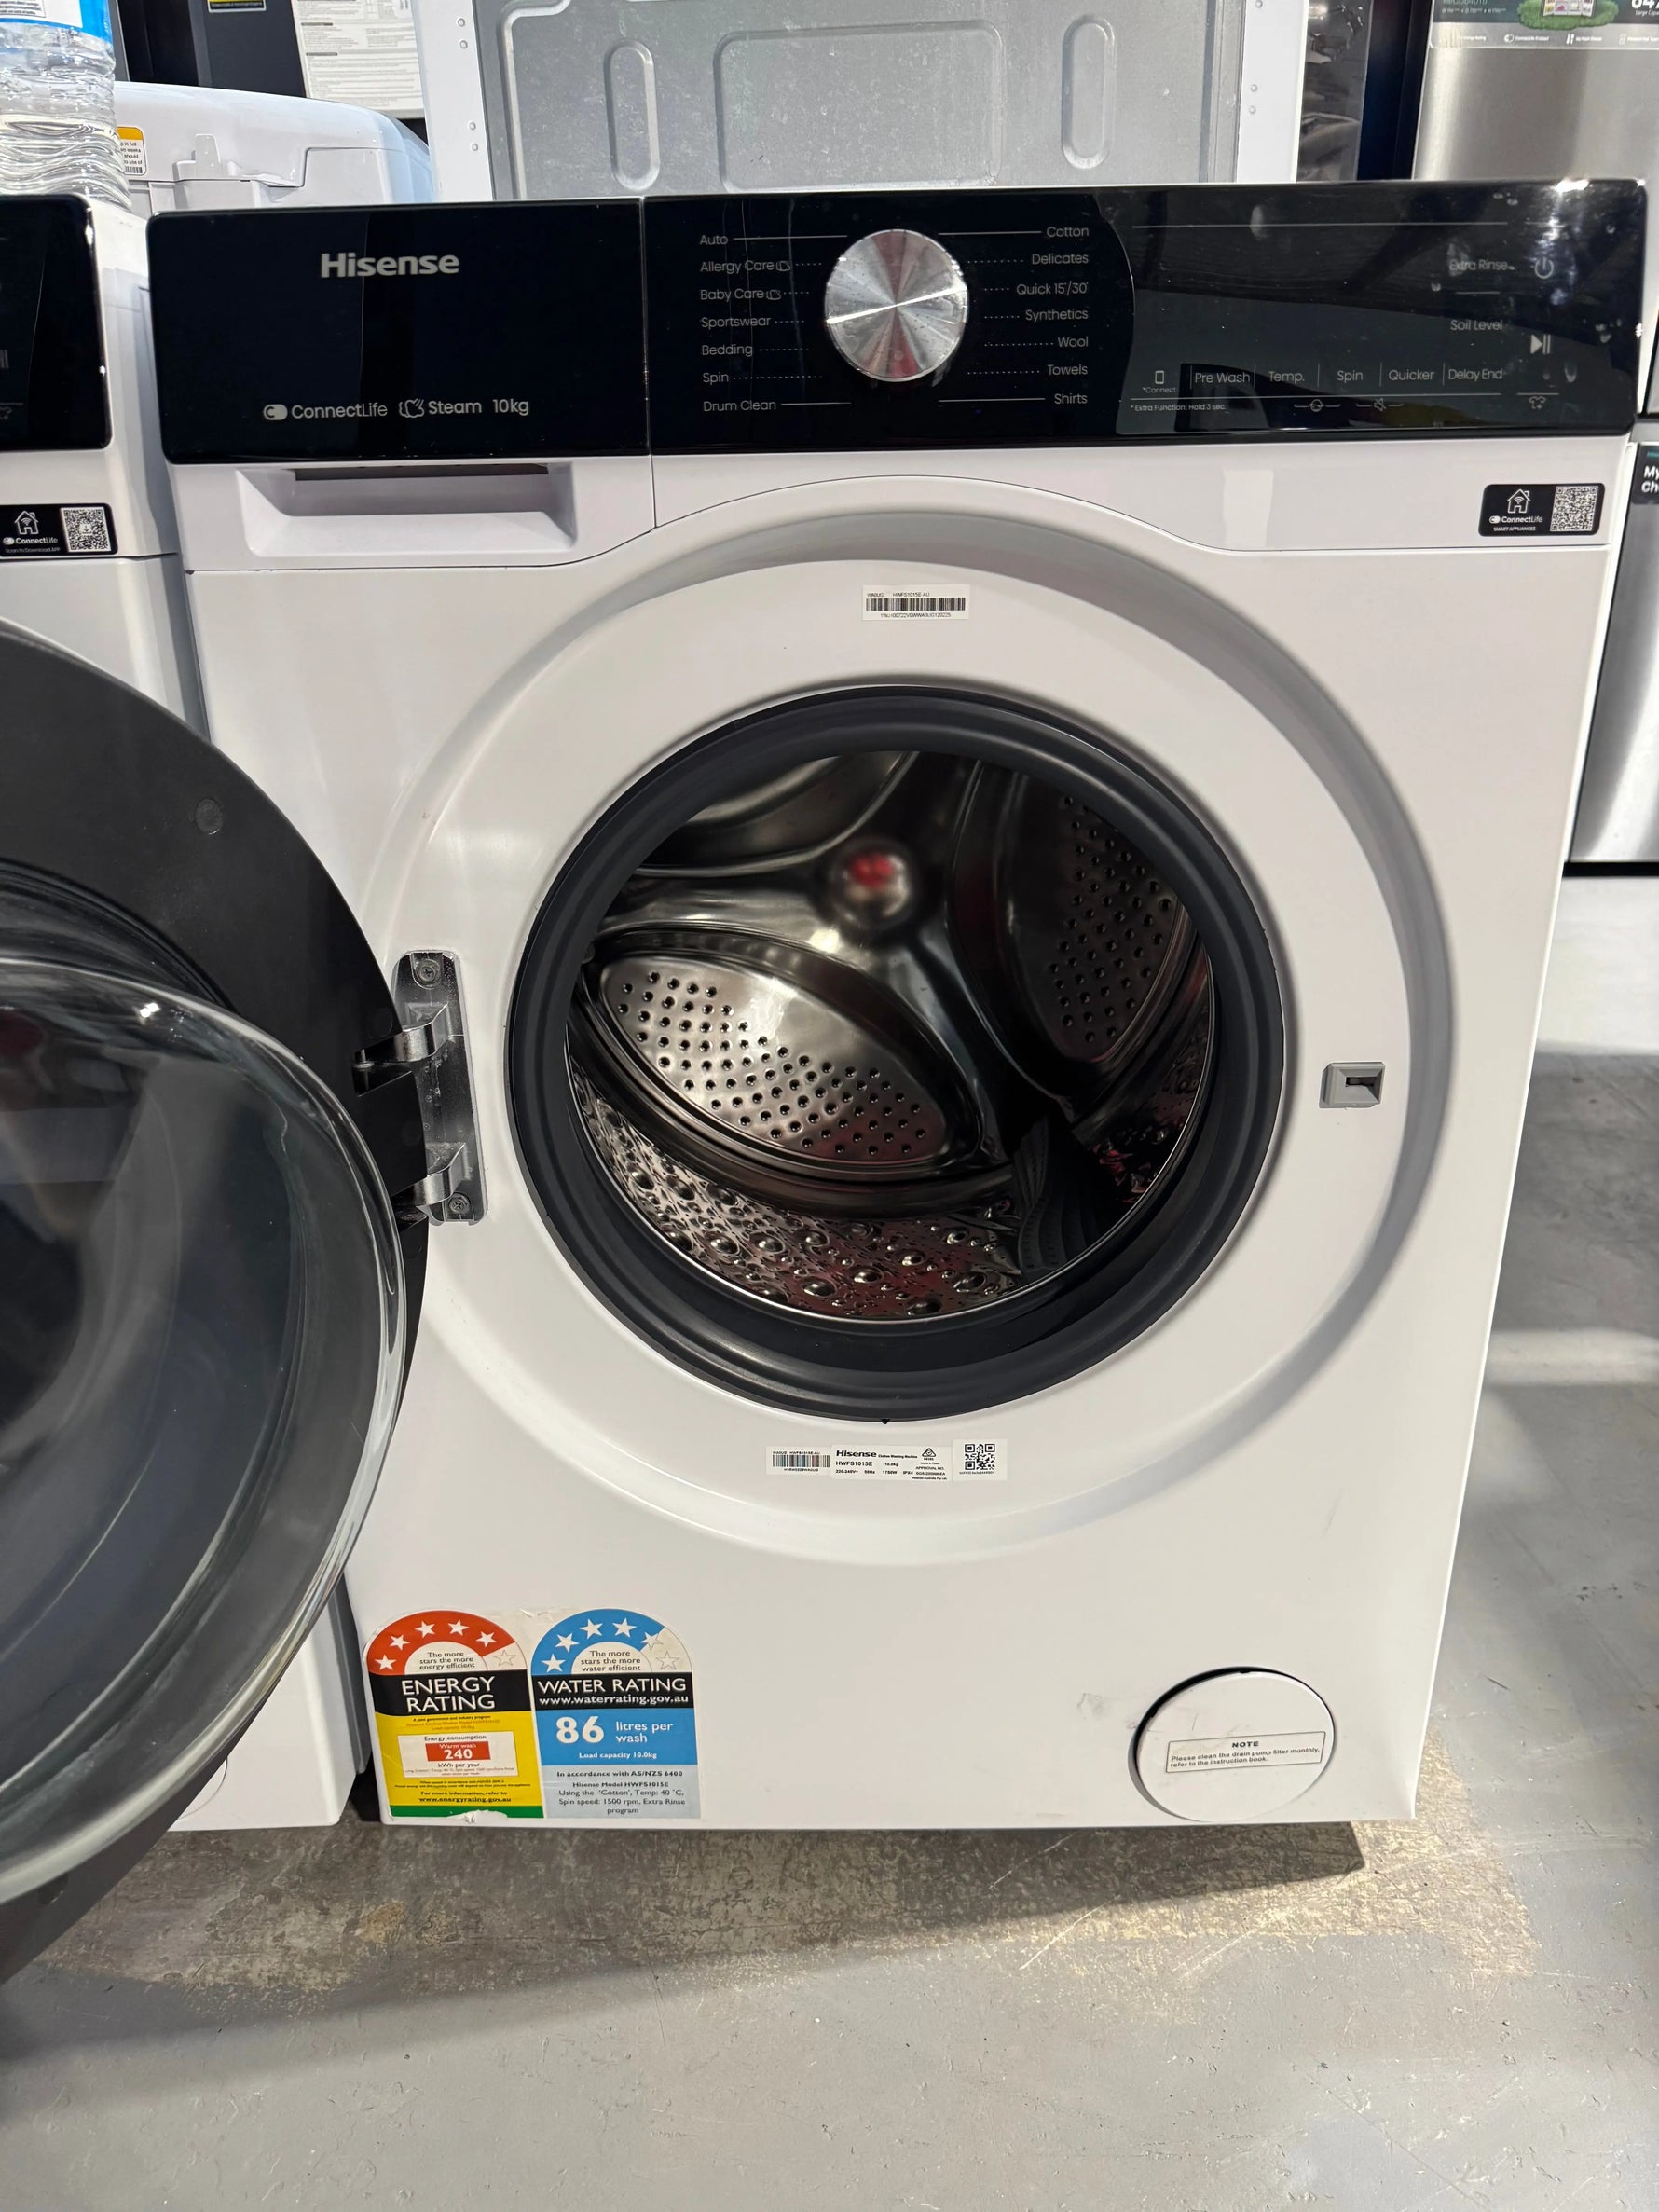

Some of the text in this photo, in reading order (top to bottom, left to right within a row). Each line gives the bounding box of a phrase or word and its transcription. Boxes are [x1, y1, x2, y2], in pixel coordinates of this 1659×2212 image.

[1046, 226, 1090, 238] Cotton
[700, 234, 728, 246] Auto
[321, 252, 460, 278] Hisense
[1031, 253, 1089, 266] Delicates
[1449, 259, 1508, 271] Extra Rinse
[700, 260, 775, 274] Allergy Care
[700, 289, 764, 301] Baby Care
[1016, 282, 1051, 295] Quick
[701, 315, 771, 330] Sportswear
[1025, 309, 1089, 323] Synthetics
[1450, 319, 1503, 331] Soil Level
[1057, 337, 1089, 348] Wool
[701, 344, 753, 358] Bedding
[1047, 364, 1089, 376] Towels
[1388, 369, 1434, 381] Quicker
[1448, 368, 1503, 382] Delay End
[703, 372, 730, 386] Spin
[1195, 372, 1251, 383] Pre Wash
[1268, 371, 1305, 385] Temp.
[1337, 370, 1364, 384] Spin
[703, 399, 776, 412] Drum Clean
[1053, 393, 1088, 405] Shirts
[292, 398, 529, 419] ConnectLife Steam 10kg
[15, 536, 59, 545] ConnectLife
[836, 1449, 877, 1458] Hisense
[401, 1676, 495, 1696] ENERGY
[537, 1678, 686, 1695] WATER RATING
[406, 1694, 496, 1713] RATING
[539, 1694, 689, 1706] www.waterrating.gov.au
[555, 1715, 605, 1744] 86
[615, 1721, 673, 1734] litres per
[615, 1733, 648, 1743] wash
[1231, 1740, 1260, 1749] NOTE
[444, 1748, 473, 1760] 240
[635, 1789, 659, 1797] Temp:
